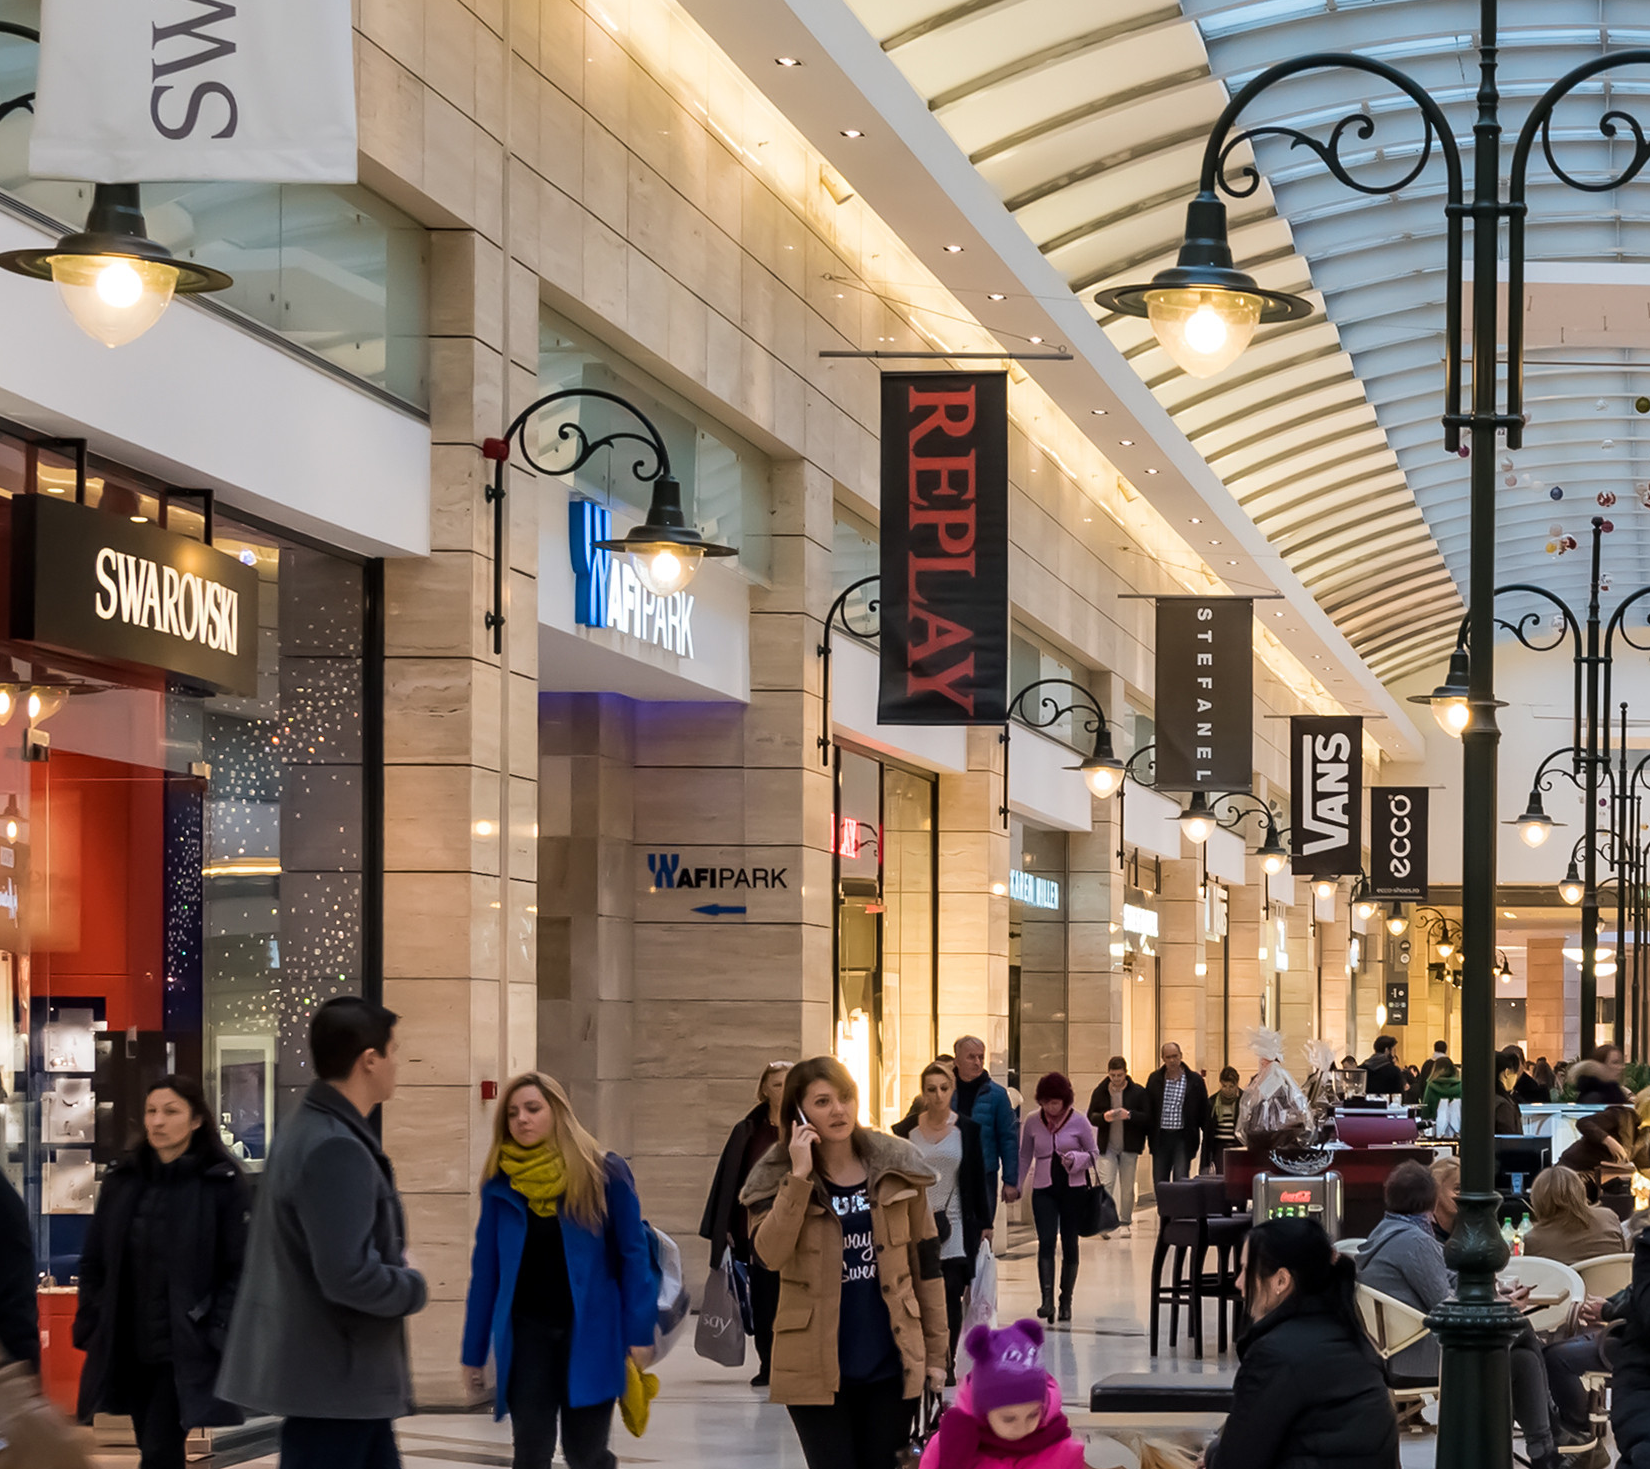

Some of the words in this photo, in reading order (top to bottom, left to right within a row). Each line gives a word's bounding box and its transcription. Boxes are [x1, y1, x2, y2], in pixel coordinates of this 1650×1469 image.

[95, 547, 239, 656] SWAROVSKI
[906, 384, 977, 718] REPLAY
[1196, 607, 1213, 782] STEFANEL
[1302, 733, 1351, 857] VANS
[1388, 794, 1412, 879] ecco
[647, 853, 788, 889] WAFIPARK
